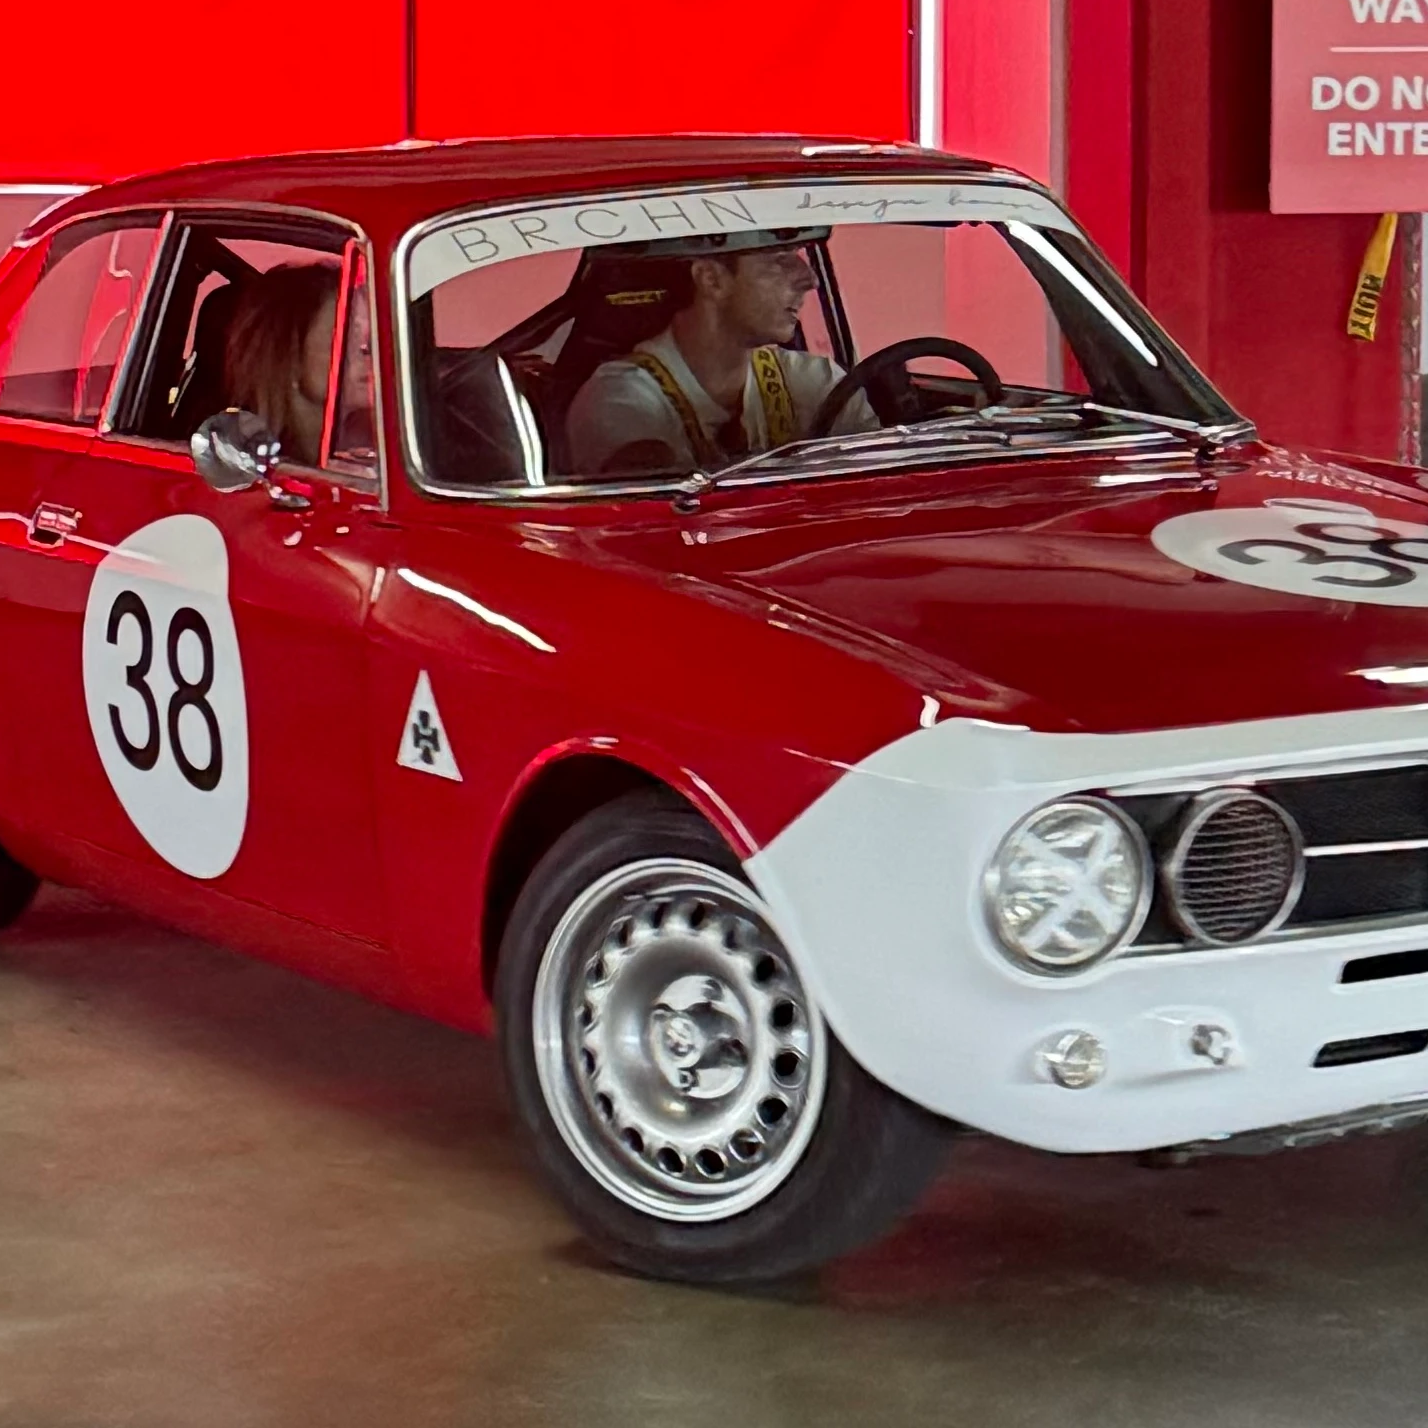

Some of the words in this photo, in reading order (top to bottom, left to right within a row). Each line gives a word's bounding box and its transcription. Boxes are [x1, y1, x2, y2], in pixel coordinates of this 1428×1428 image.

[1311, 76, 1380, 112] DO
[449, 193, 759, 265] BRCHN
[105, 589, 224, 793] 38
